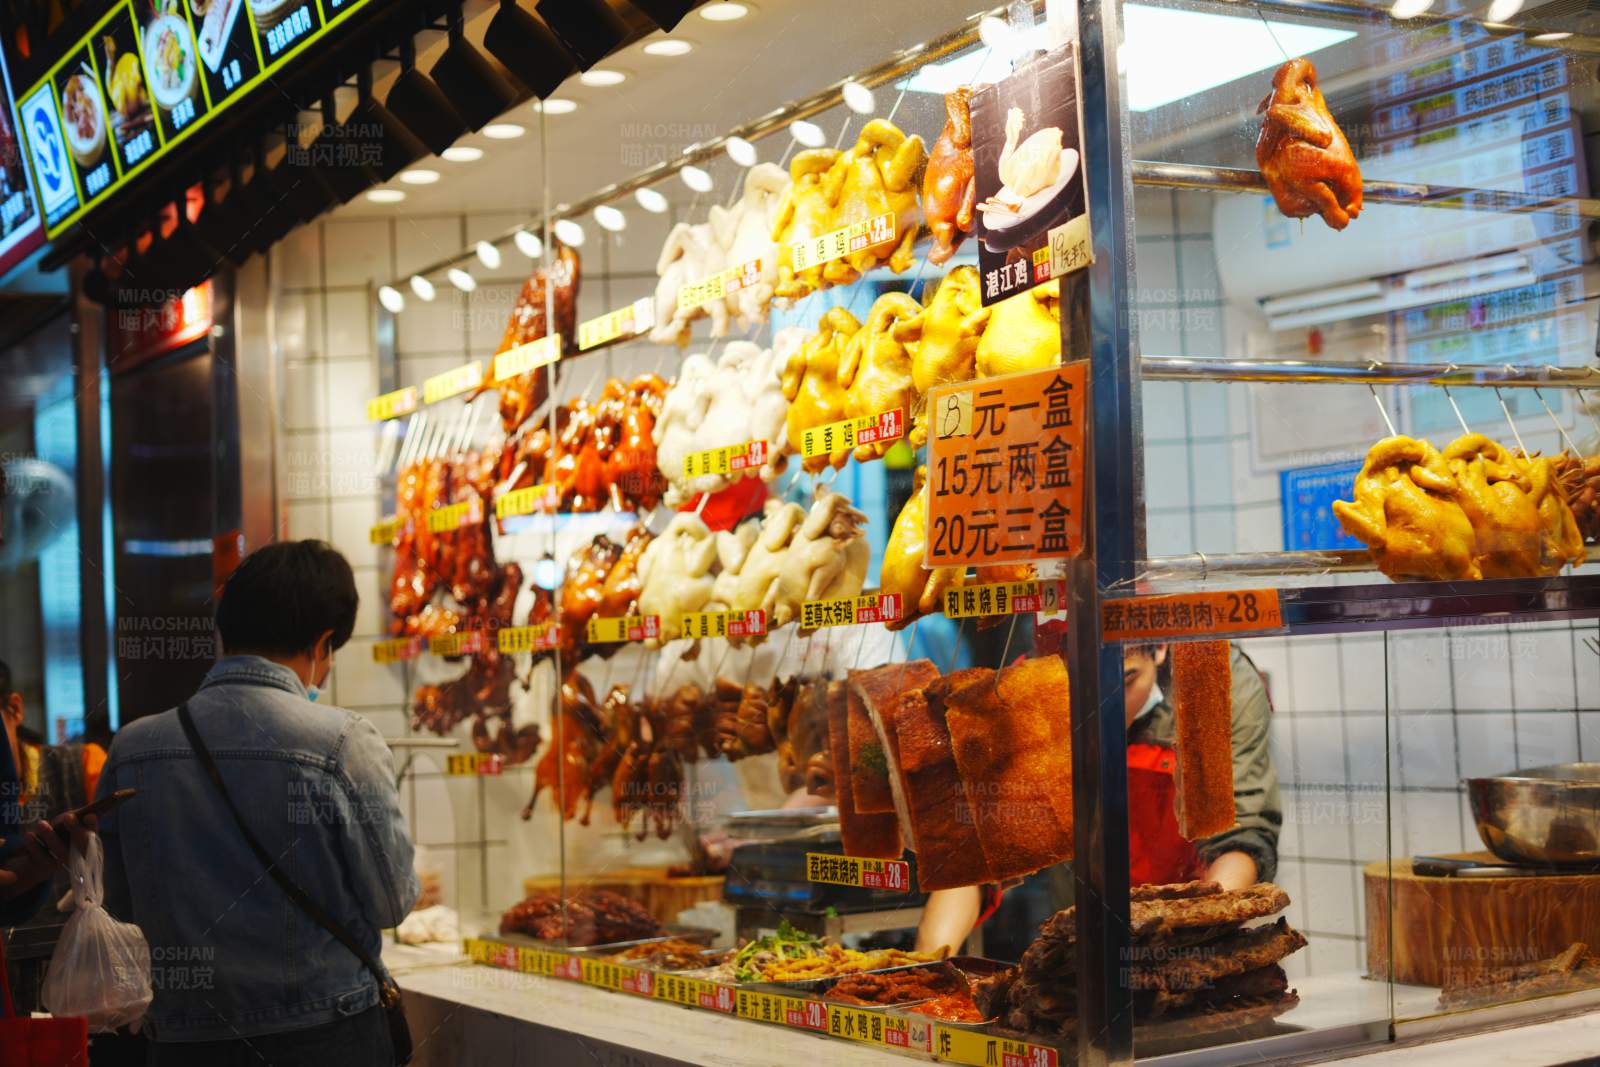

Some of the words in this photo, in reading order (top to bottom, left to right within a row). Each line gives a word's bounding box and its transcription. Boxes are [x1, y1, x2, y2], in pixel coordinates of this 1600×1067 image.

[986, 258, 1027, 299] 湛江鸡
[936, 434, 1072, 497] 15元两盒
[933, 498, 1070, 558] 20元三盒
[804, 599, 852, 626] 至尊太爷鸡
[947, 585, 1007, 616] 和味烧骨
[1103, 602, 1214, 631] 荔枝碳烧肉
[810, 856, 859, 885] 荔枝碳烧肉
